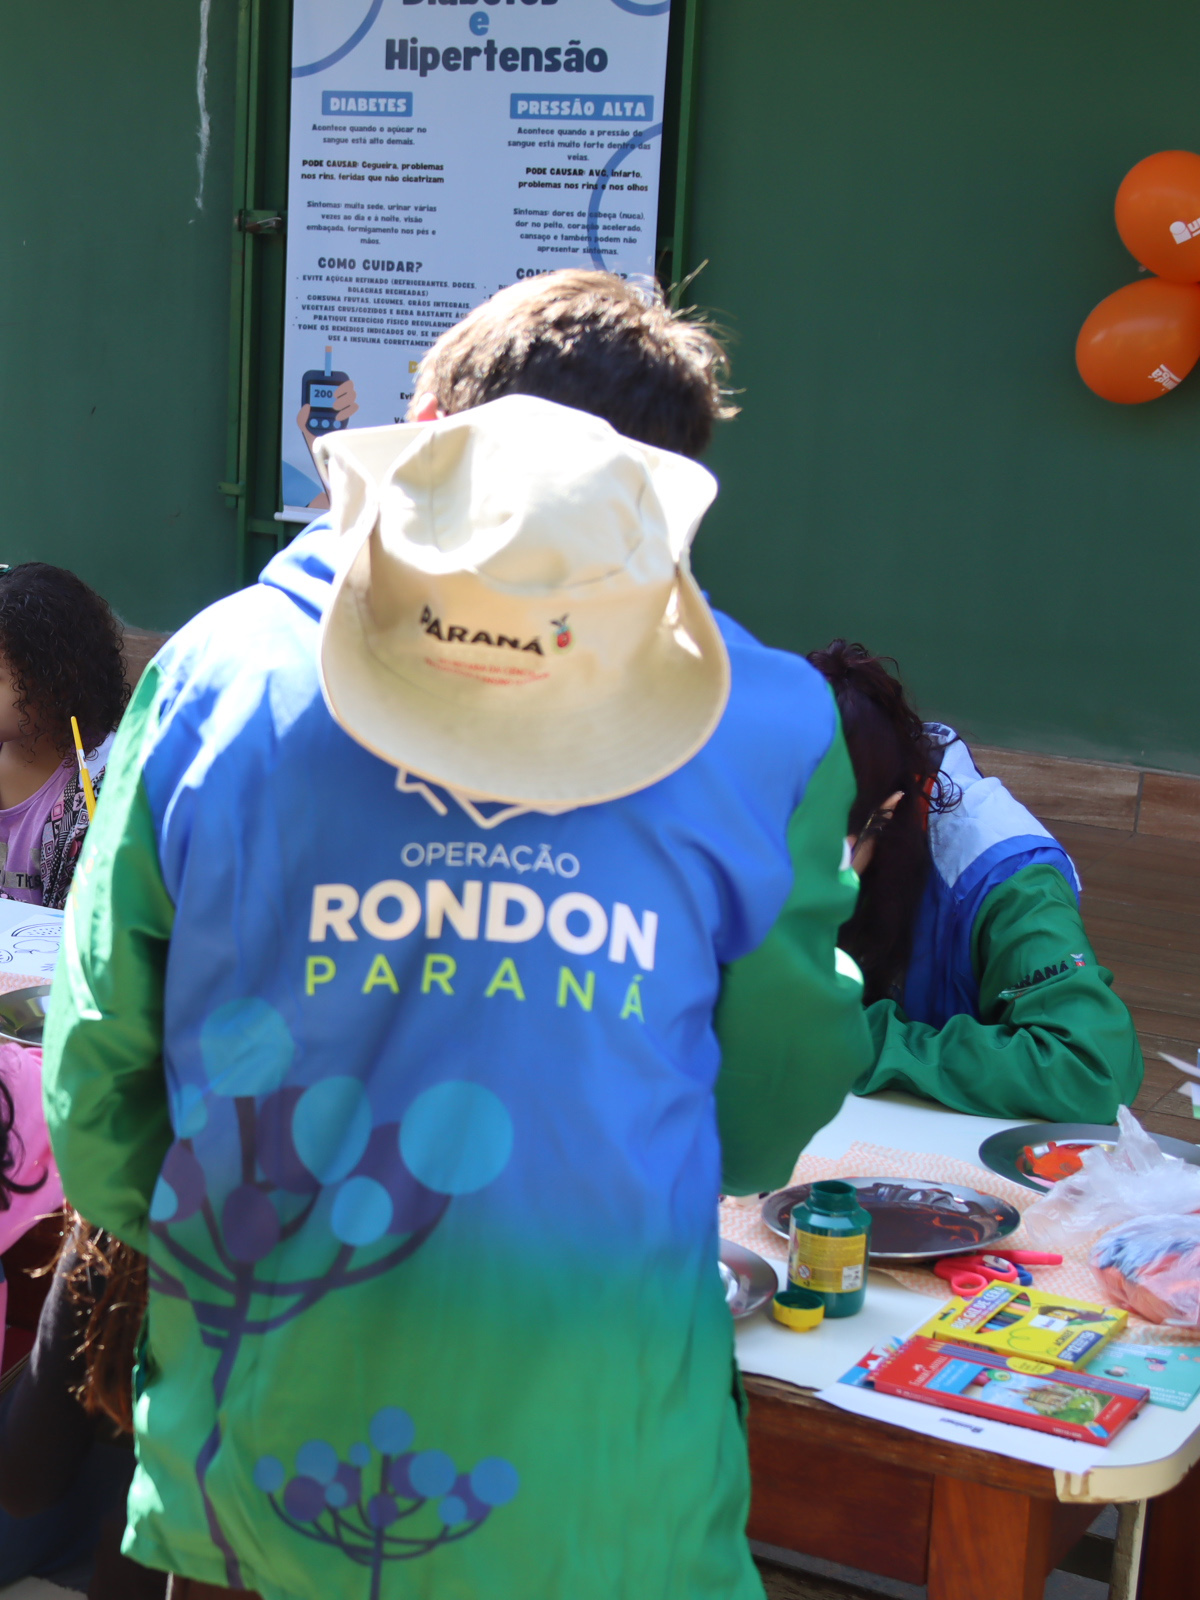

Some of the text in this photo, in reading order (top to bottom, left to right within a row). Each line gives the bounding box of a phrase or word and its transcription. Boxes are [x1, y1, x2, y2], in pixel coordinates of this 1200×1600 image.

[469, 11, 490, 36] e
[385, 37, 608, 77] Hipertensão
[330, 97, 407, 112] DIABETES
[517, 98, 646, 117] PRESSÃO ALTA
[387, 124, 414, 134] açúcar
[518, 127, 554, 135] Acontece
[597, 129, 629, 137] pressão
[323, 137, 348, 145] sangue
[508, 140, 535, 148] sangue
[539, 140, 555, 148] está
[607, 142, 635, 150] dentro
[327, 160, 359, 168] CAUSAR:
[402, 163, 444, 171] problemas
[526, 167, 547, 175] PODE
[550, 168, 586, 176] CAUSAR:
[339, 173, 364, 181] feridas
[402, 175, 444, 183] cicatrizam
[518, 181, 561, 189] problemas
[514, 208, 549, 216] Sintomas:
[552, 209, 574, 217] dores
[589, 211, 616, 220] cabeça
[348, 225, 399, 234] formigamento
[417, 228, 429, 236] pés
[520, 233, 551, 241] cansaço
[594, 235, 620, 243] podem
[537, 245, 618, 255] apresentar sintomas.
[318, 257, 423, 273] COMO CUIDAR?
[326, 275, 353, 283] AÇÚCAR
[348, 286, 382, 295] BOLACHAS
[307, 294, 341, 302] CONSUMA
[302, 304, 335, 312] VEGETAIS
[338, 305, 387, 314] CRUS/COZIDOS
[417, 310, 452, 318] BASTANTE
[313, 314, 347, 322] PRATIQUE
[350, 316, 384, 324] EXERCÍCIO
[387, 317, 409, 325] FÍSICO
[332, 325, 364, 333] REMÉDIOS
[367, 327, 404, 336] INDICADOS
[350, 336, 381, 344] INSULINA
[384, 338, 435, 347] CORRETAMENT
[314, 389, 332, 398] 200
[420, 604, 544, 656] PARANÁ
[401, 841, 580, 879] OPERAÇÃO
[308, 879, 658, 971] RONDON
[305, 952, 646, 1024] PARANÁ
